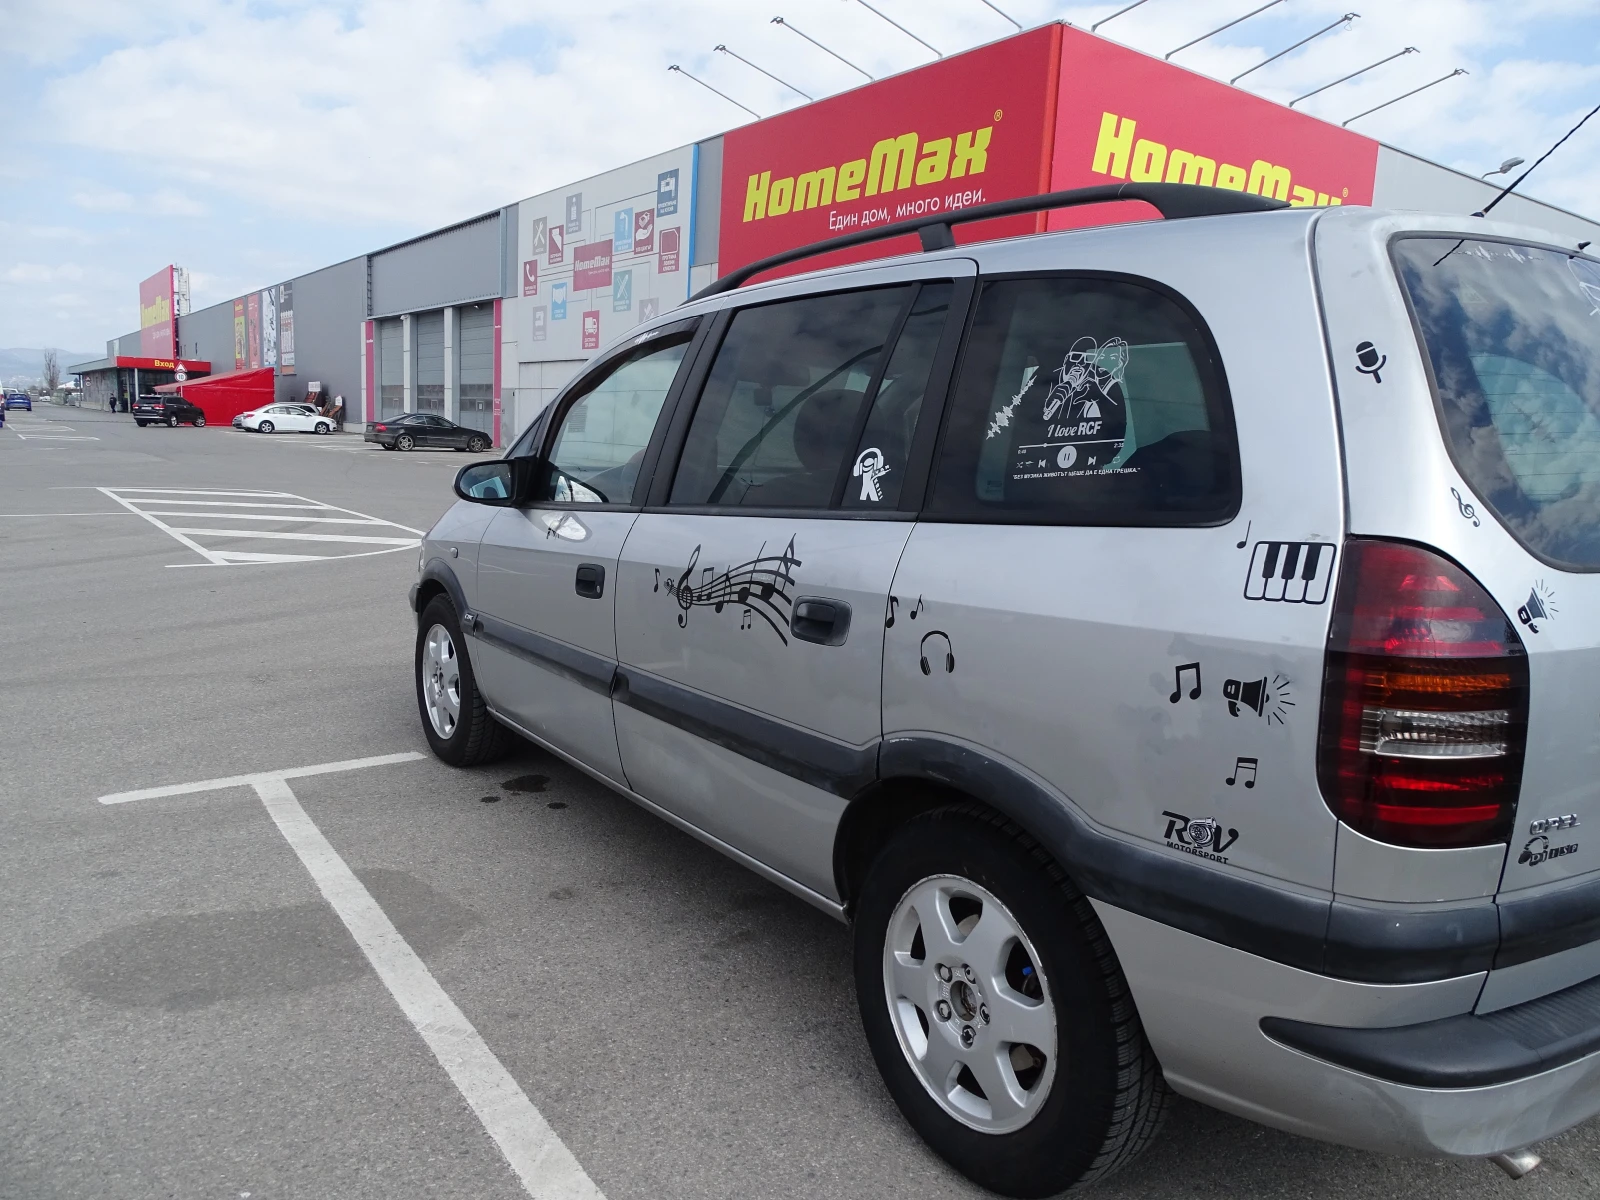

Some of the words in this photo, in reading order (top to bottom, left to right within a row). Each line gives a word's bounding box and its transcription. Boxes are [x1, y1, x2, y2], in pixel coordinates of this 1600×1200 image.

[743, 126, 993, 223] HomeMax
[829, 210, 858, 231] Един
[861, 210, 891, 227] дом,
[896, 196, 940, 218] много
[944, 188, 986, 210] идеи.
[154, 360, 175, 369] Вход
[1047, 424, 1055, 438] I
[1055, 424, 1078, 438] love
[1078, 421, 1102, 435] RCF
[1530, 813, 1581, 835] OPEL
[1167, 841, 1229, 865] MOTORSPORT
